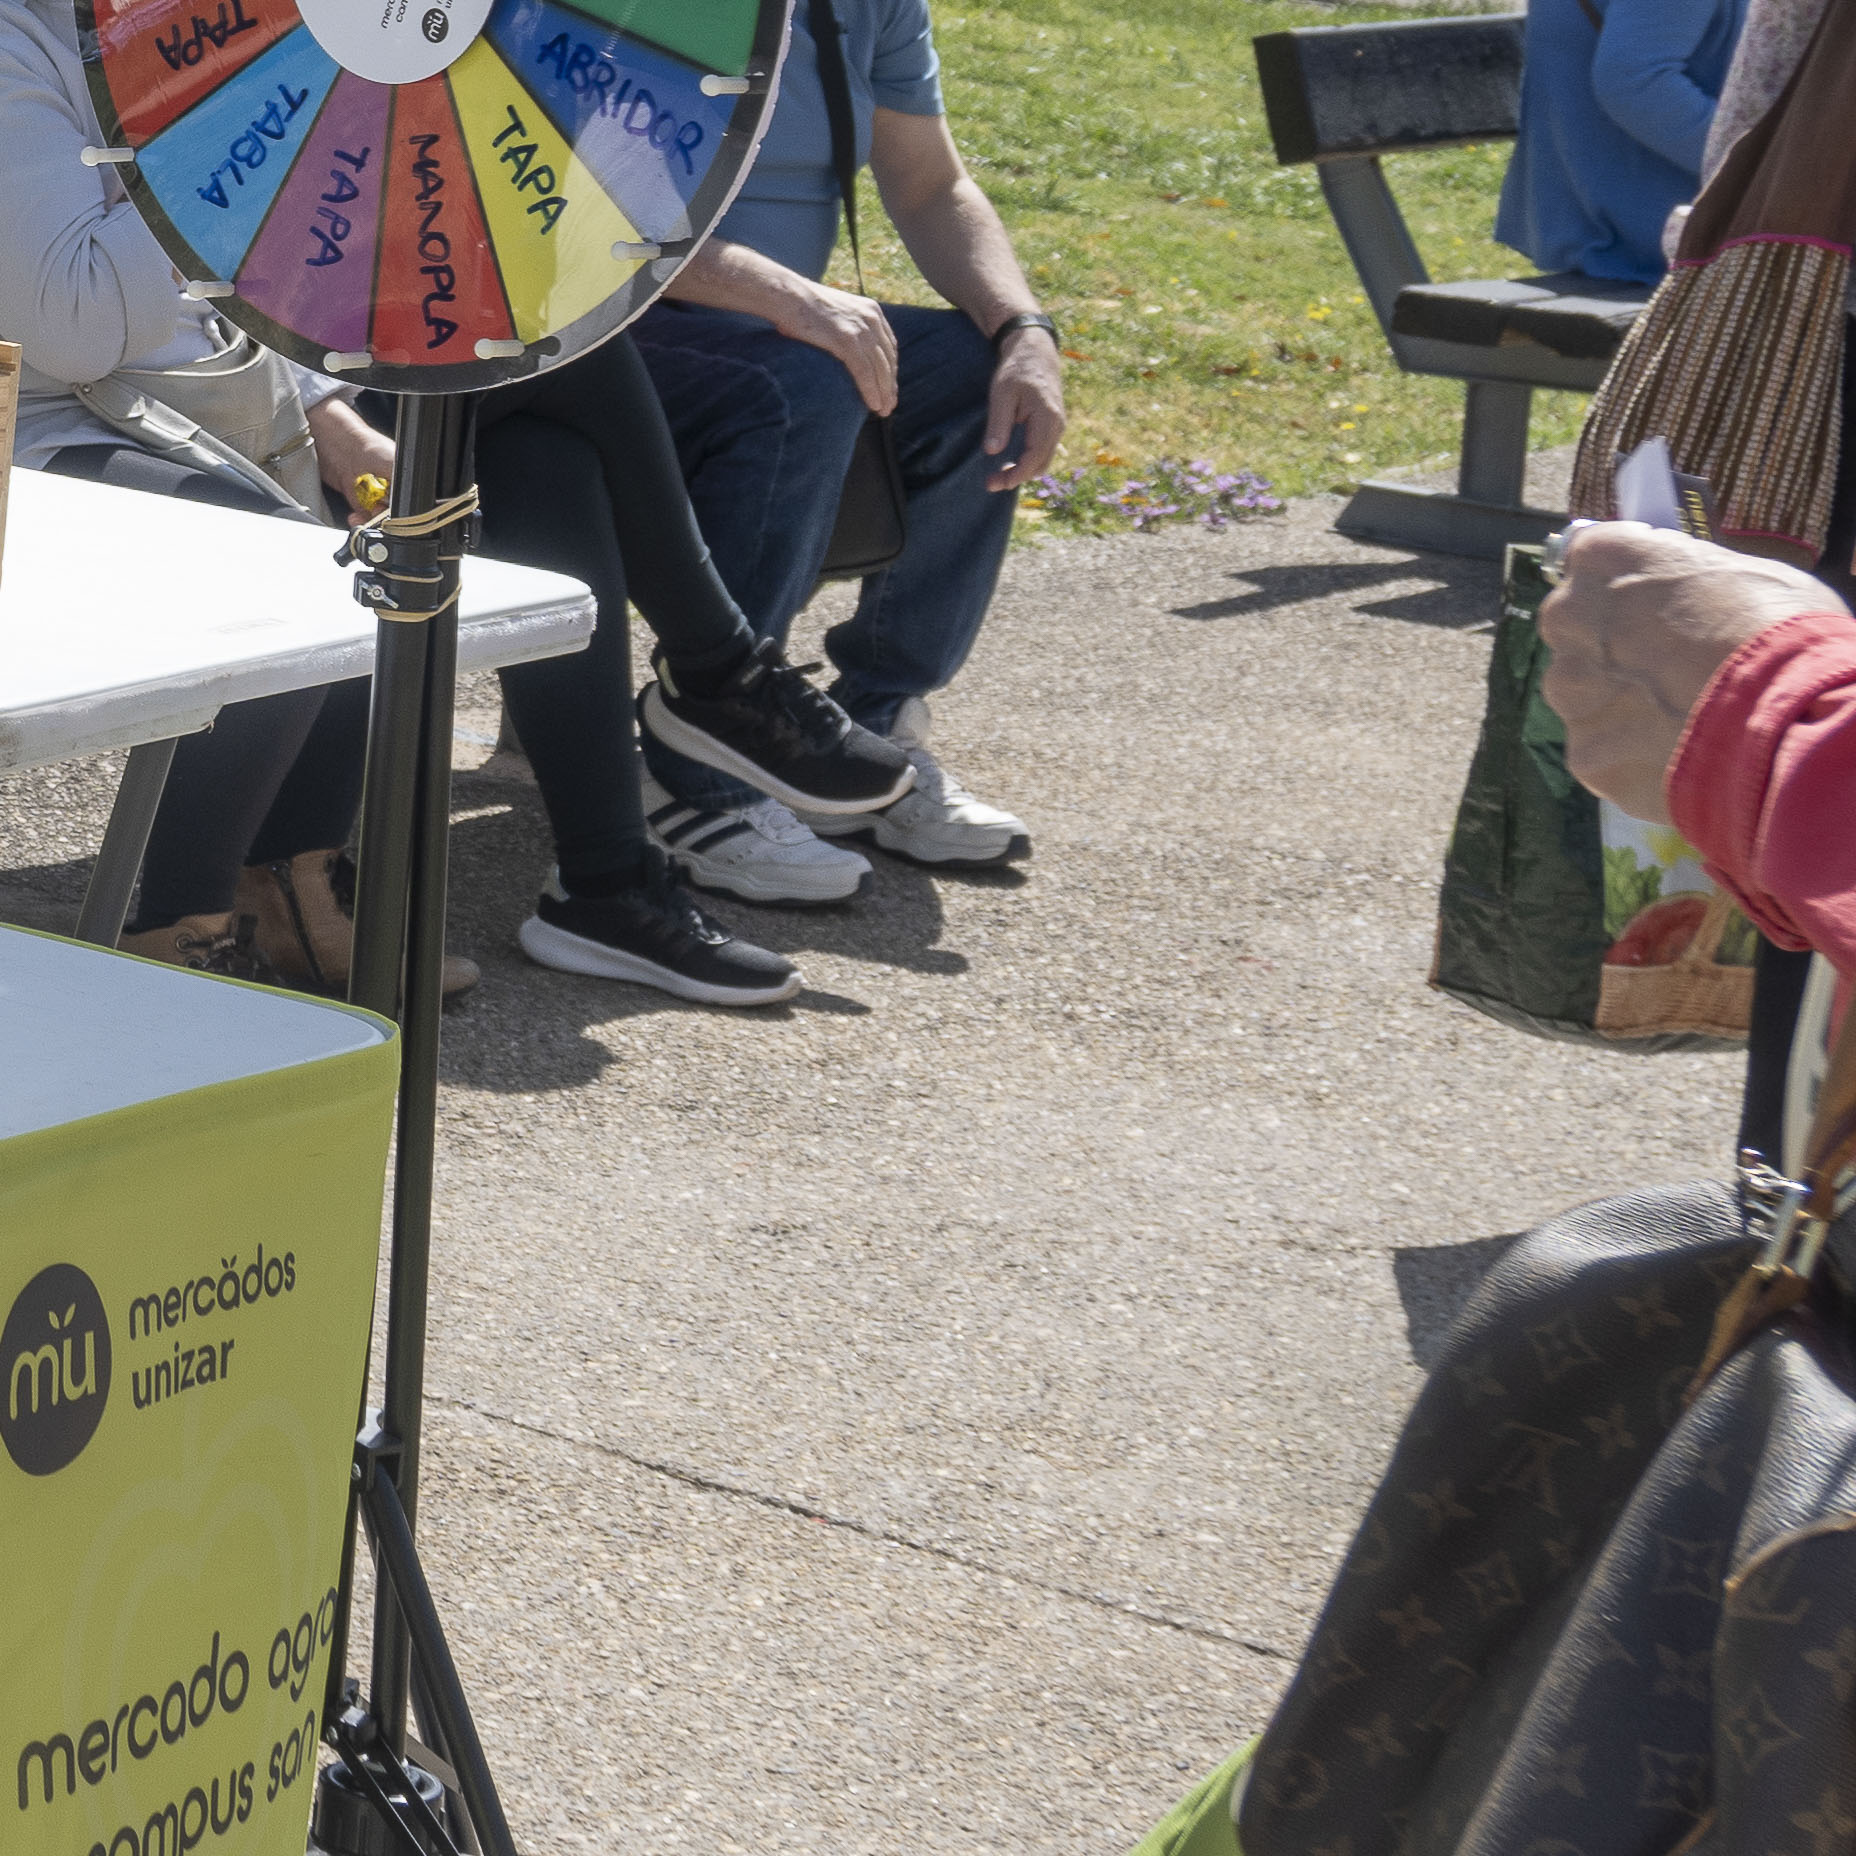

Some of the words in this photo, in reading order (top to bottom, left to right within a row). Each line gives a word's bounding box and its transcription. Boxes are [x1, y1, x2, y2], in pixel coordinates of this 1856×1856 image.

[196, 83, 309, 209] TABLA
[537, 32, 703, 176] ABRIDOR
[305, 146, 371, 267] TAPA
[492, 104, 568, 235] TAPA
[409, 133, 458, 350] MANOPLA
[132, 1338, 235, 1410] unizar
[17, 1630, 250, 1812] mercado
[266, 1709, 316, 1804] san
